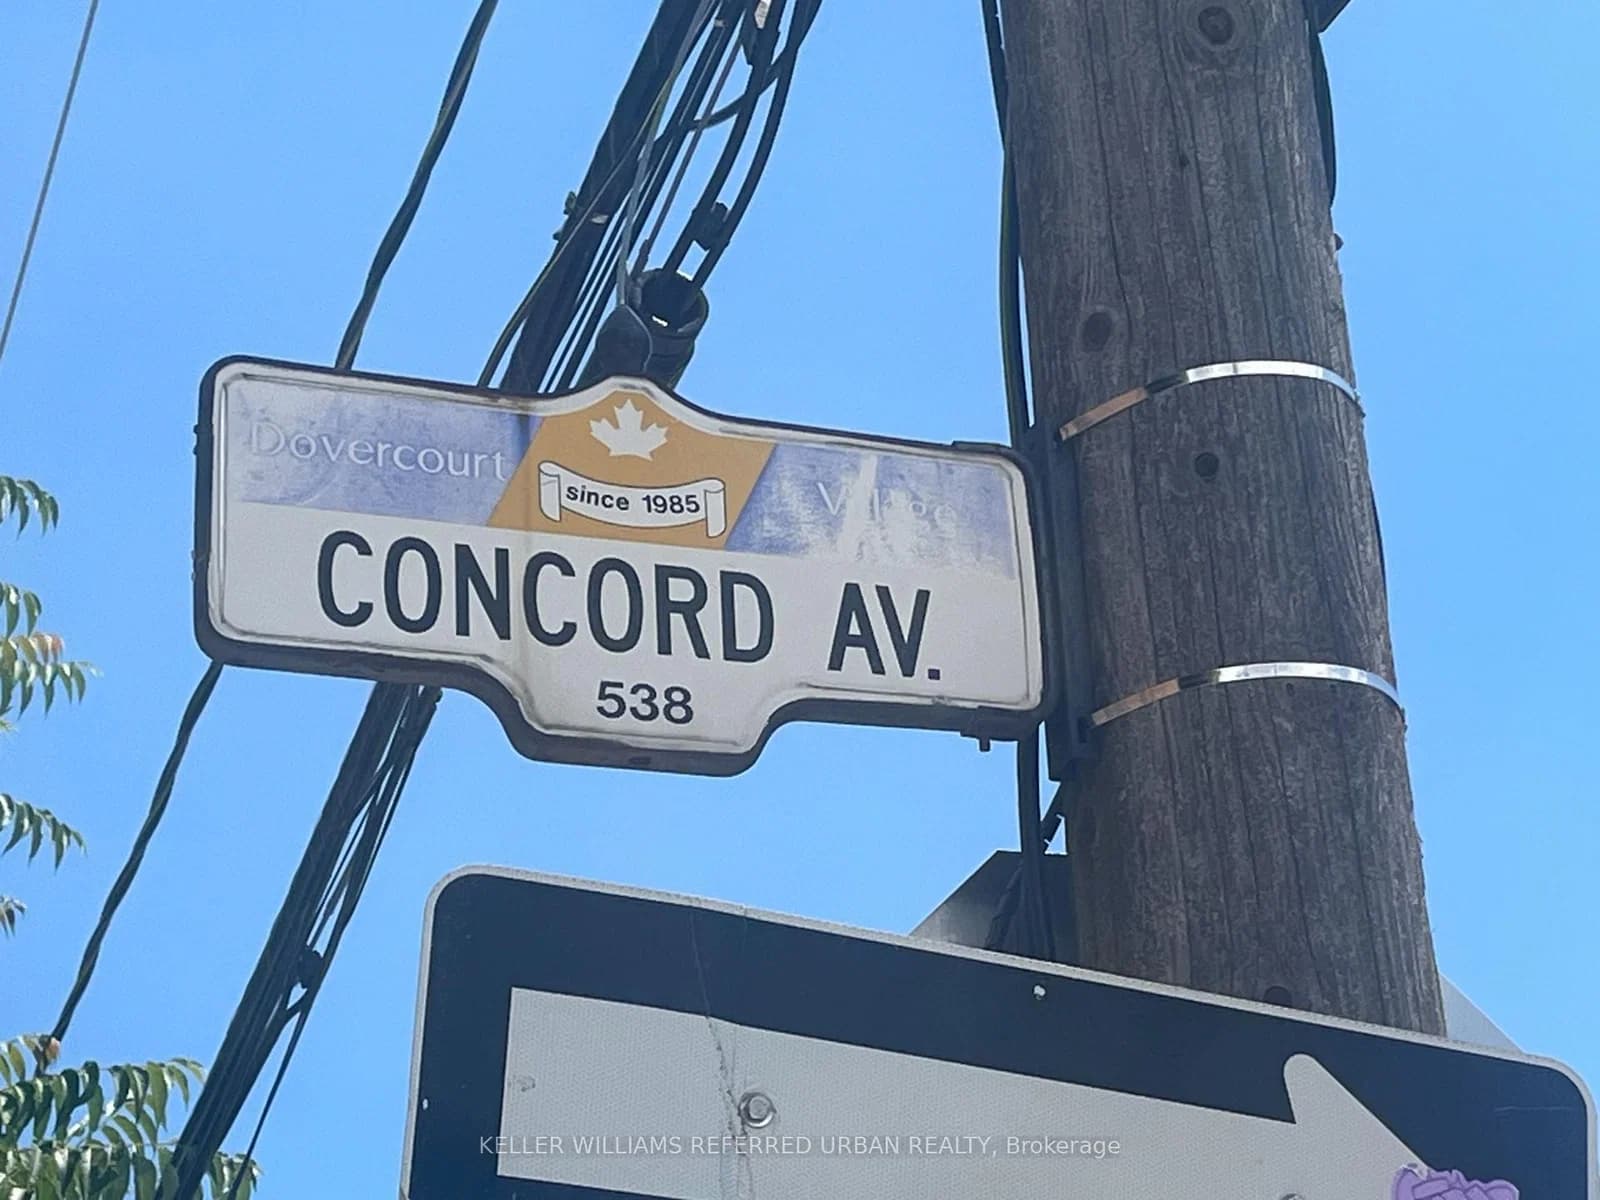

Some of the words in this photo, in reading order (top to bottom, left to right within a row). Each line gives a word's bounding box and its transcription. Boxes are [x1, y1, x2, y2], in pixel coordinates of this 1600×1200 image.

[250, 420, 507, 482] Dovercourt
[566, 484, 630, 512] since
[642, 494, 700, 514] 1985
[317, 530, 775, 664] CONCORD
[827, 582, 941, 681] AV.
[596, 681, 694, 725] 538
